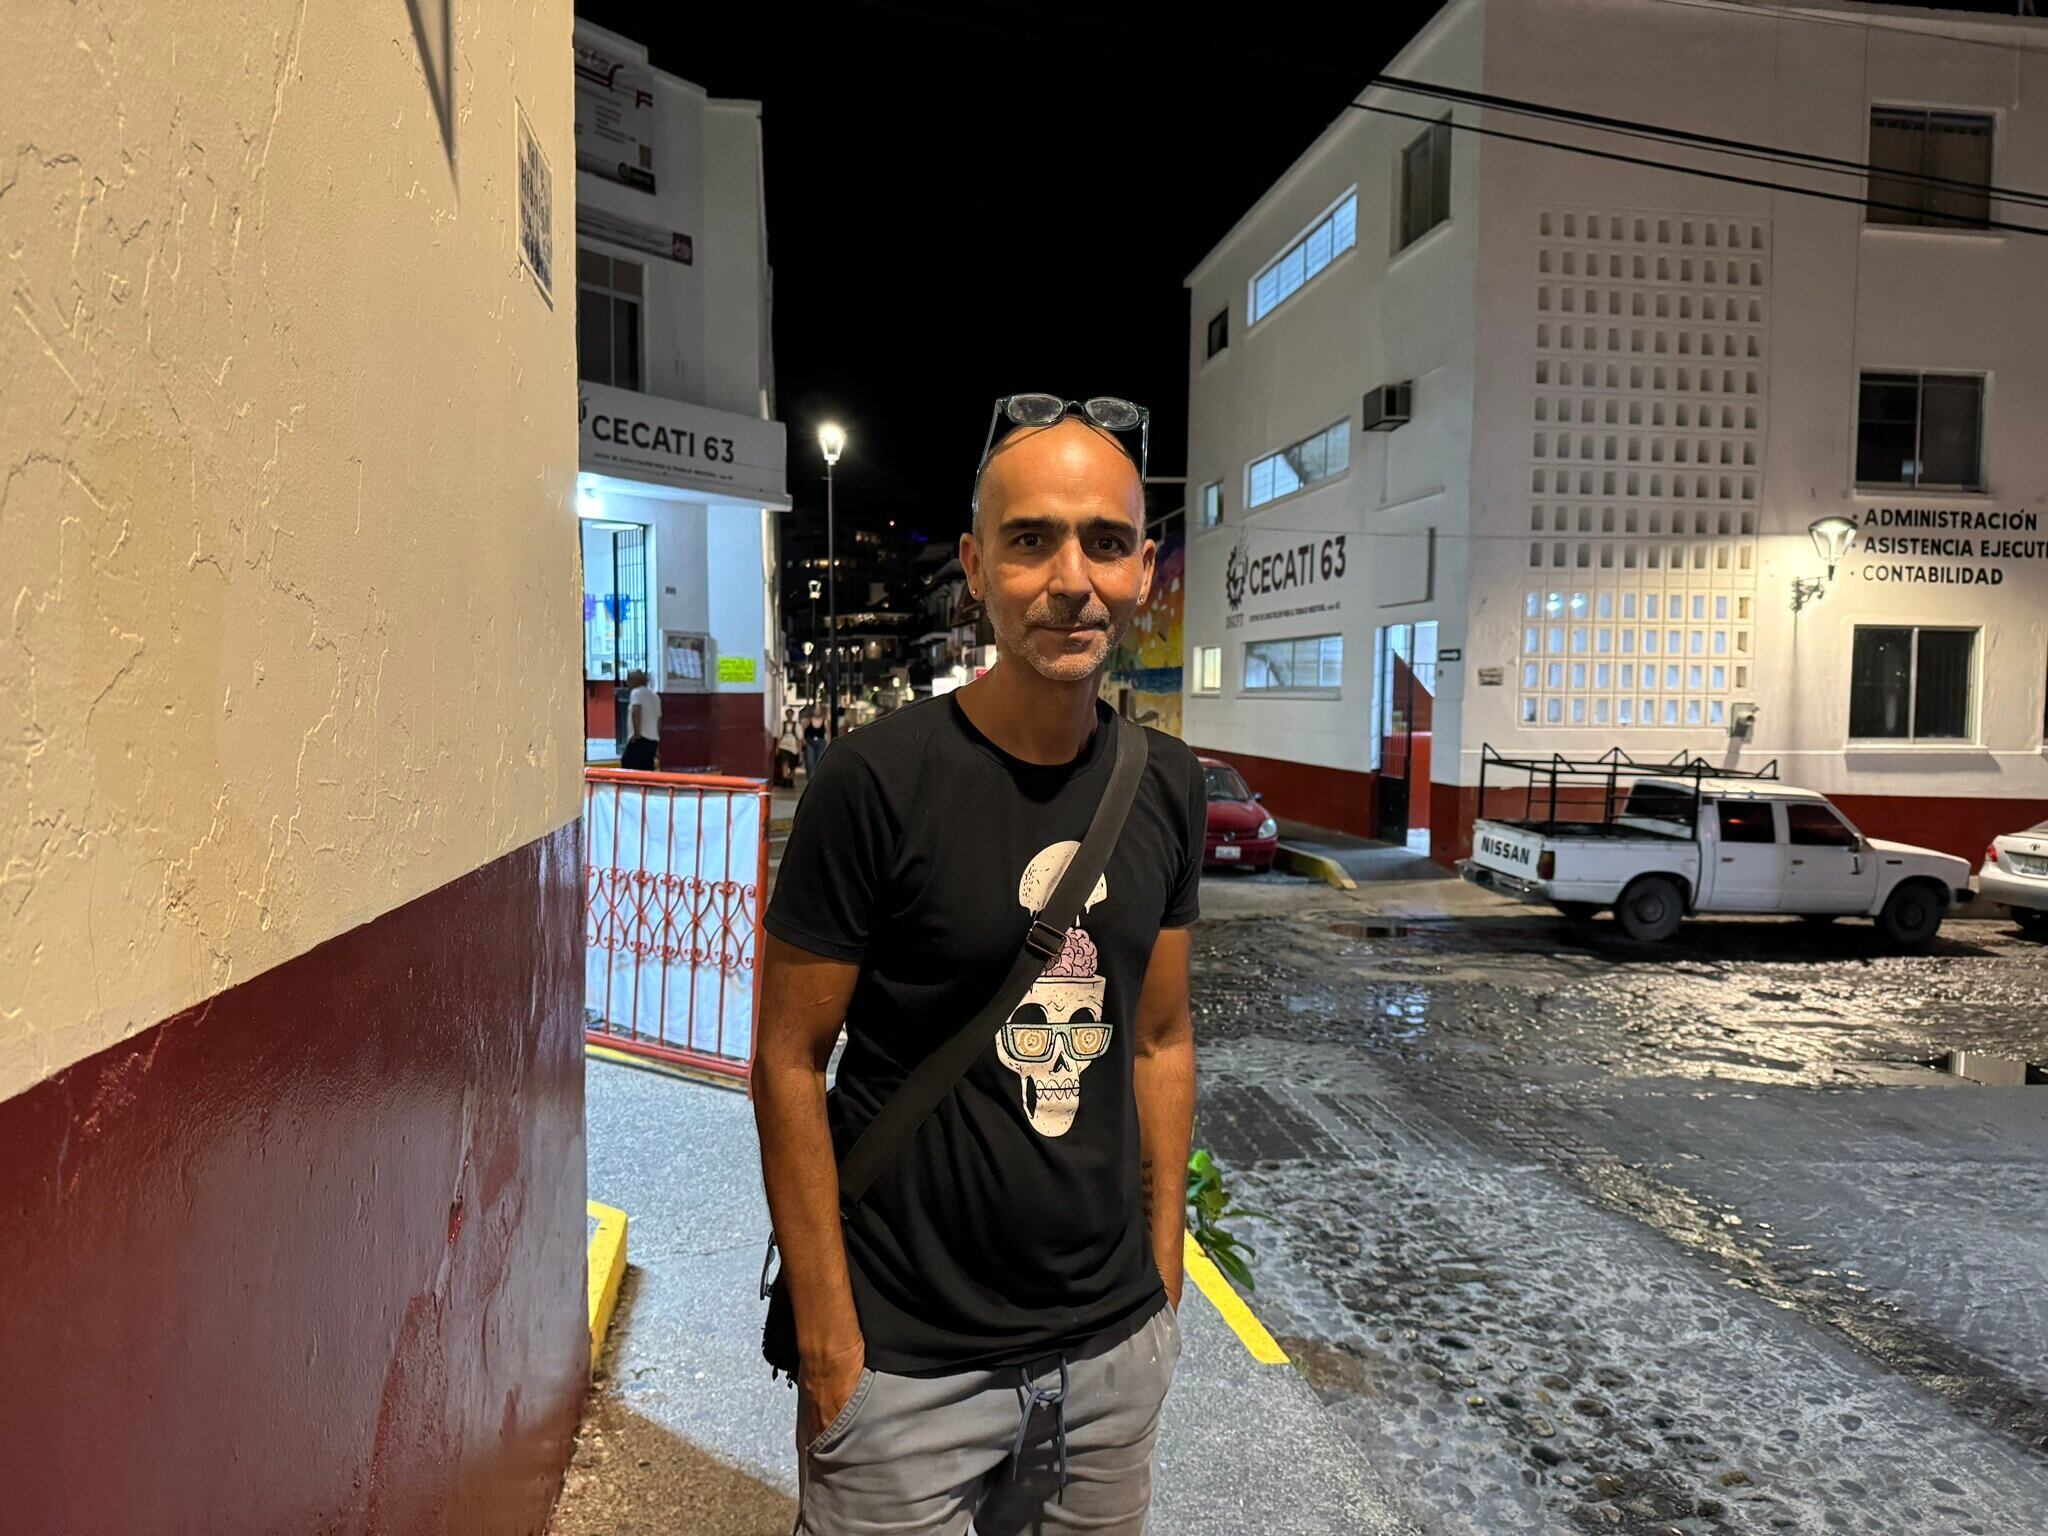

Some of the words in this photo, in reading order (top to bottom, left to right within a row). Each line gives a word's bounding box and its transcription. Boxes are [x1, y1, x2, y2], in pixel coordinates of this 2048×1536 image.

[592, 414, 696, 458] CECATI
[704, 436, 734, 465] 63
[1864, 508, 2037, 531] ADMINISTRACIÓN
[1863, 536, 1974, 558] ASISTENCIA
[1249, 543, 1315, 595] CECATI
[1321, 535, 1346, 581] 63
[1862, 565, 2004, 586] CONTABILIDAD
[1481, 836, 1530, 865] NISSAN
